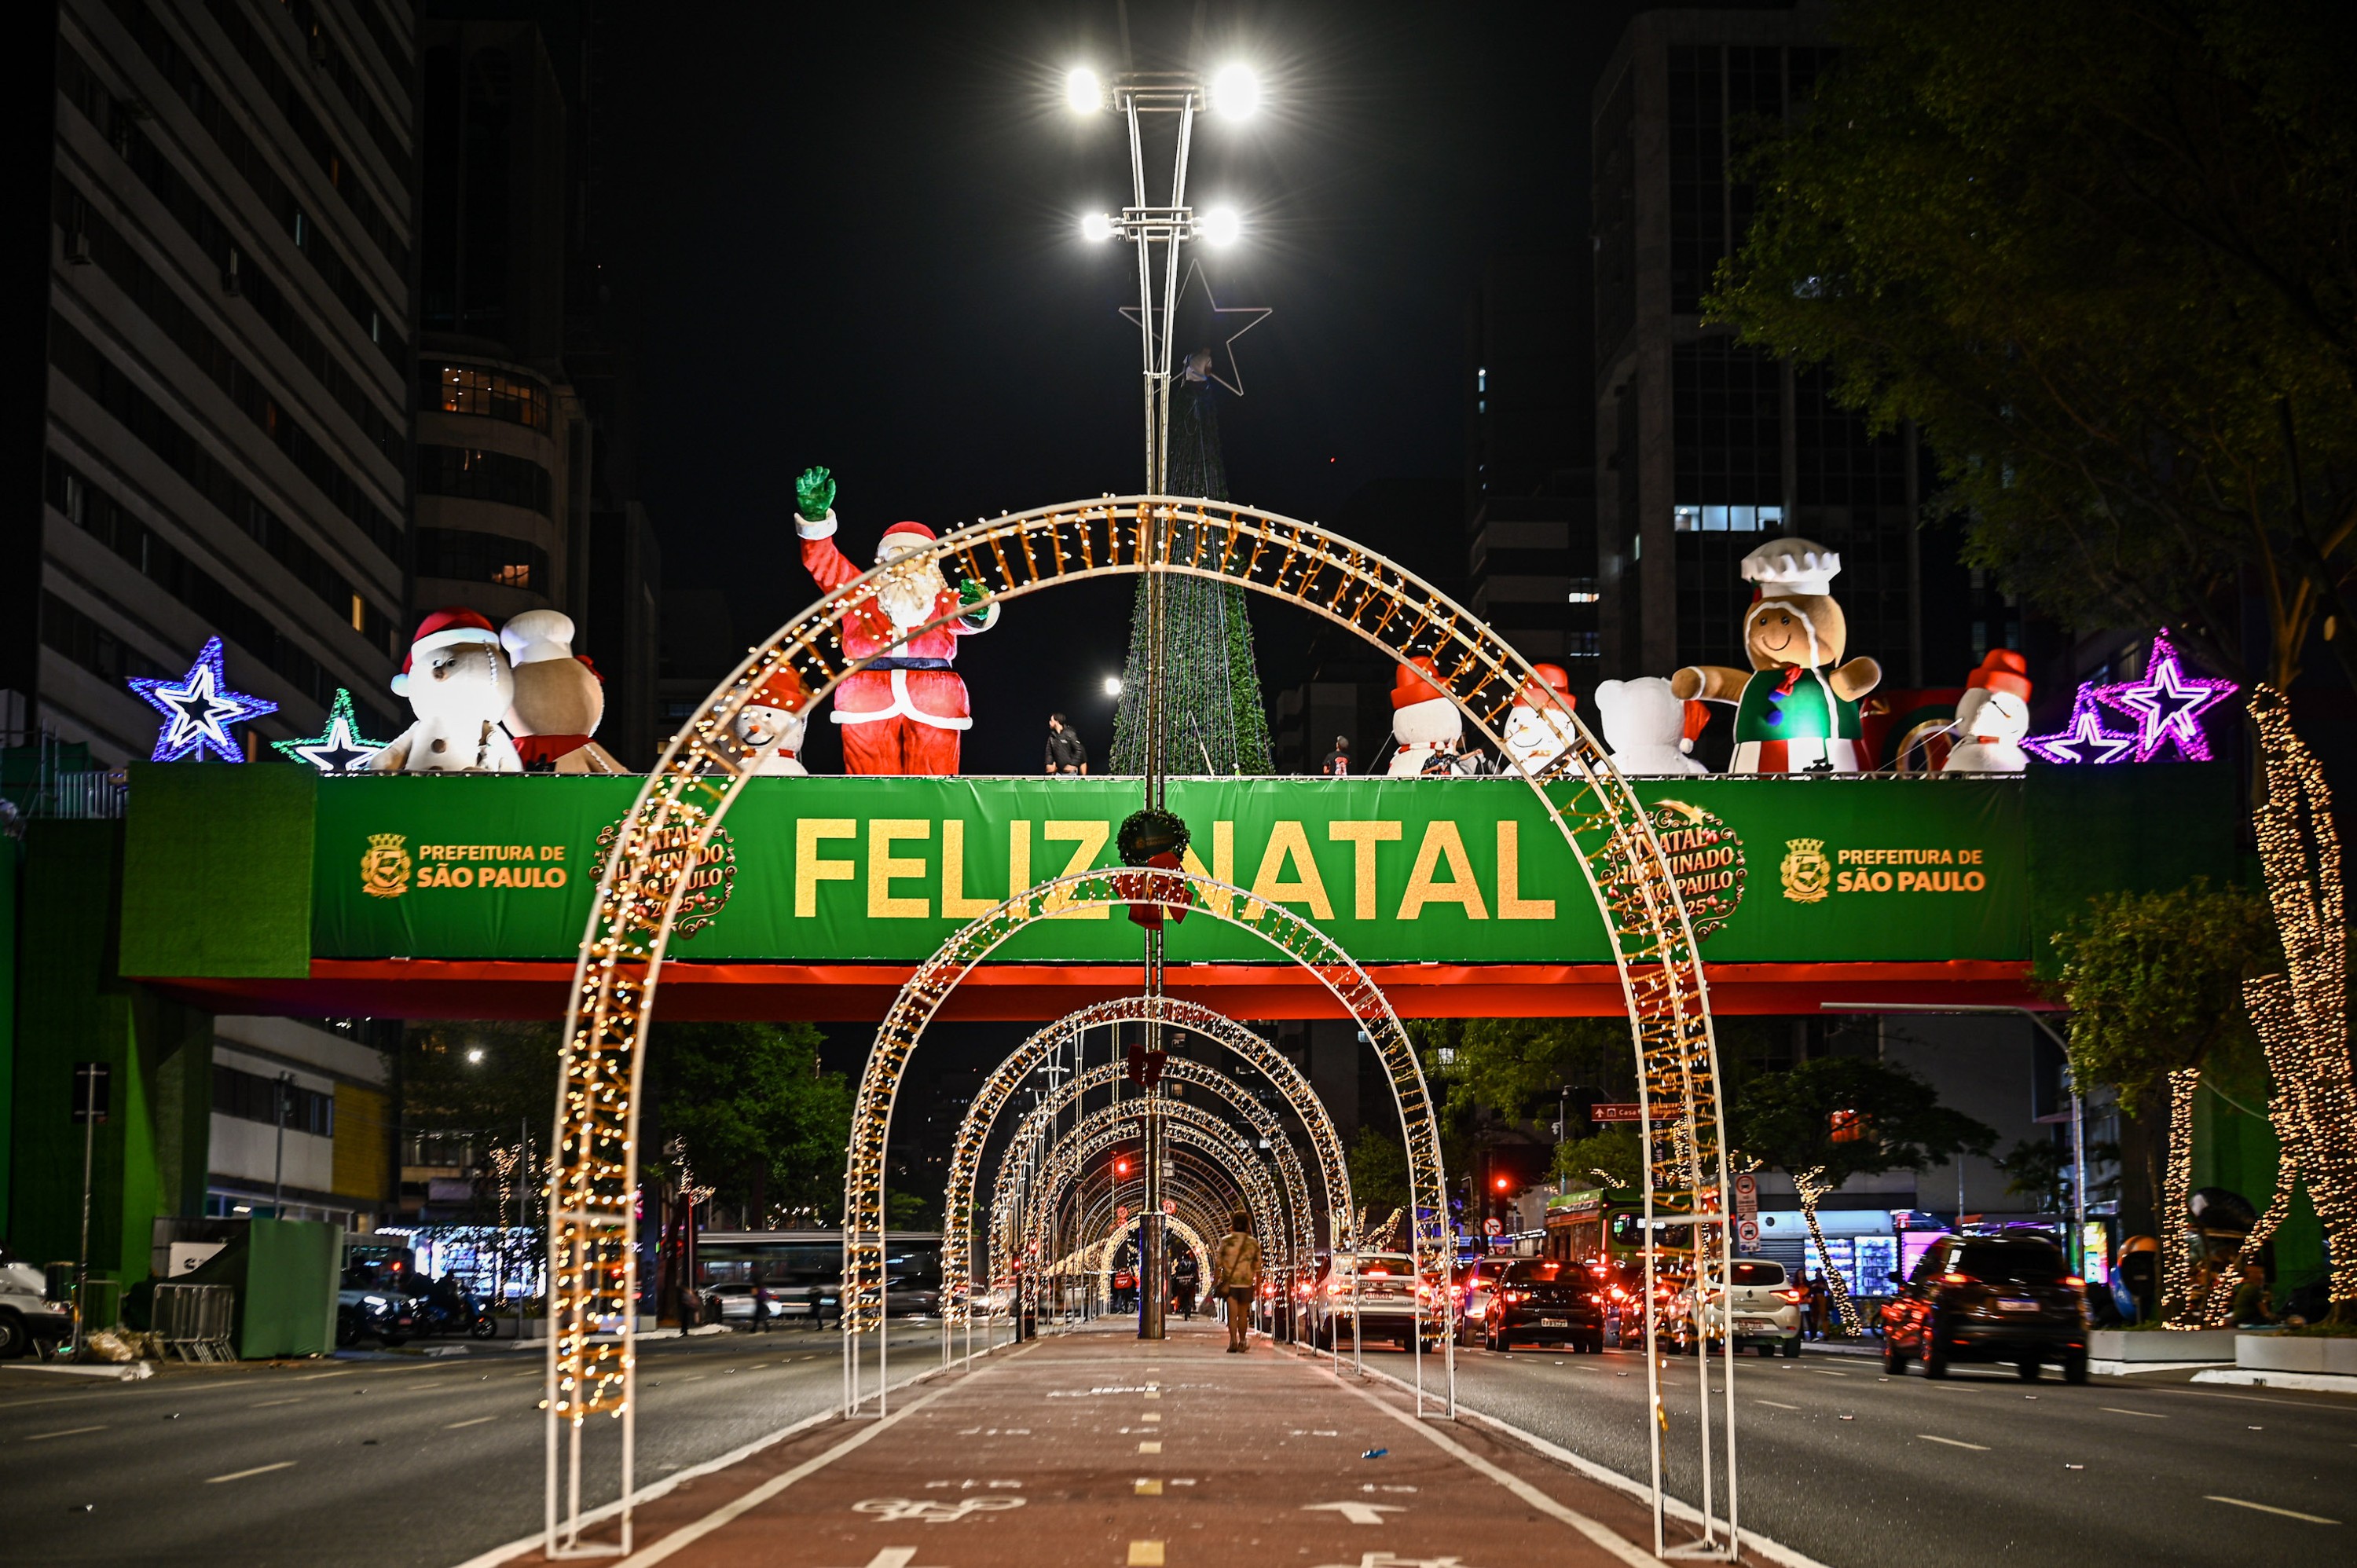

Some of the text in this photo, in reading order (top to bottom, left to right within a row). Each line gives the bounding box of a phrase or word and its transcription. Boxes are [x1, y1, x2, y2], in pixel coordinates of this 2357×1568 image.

[420, 845, 566, 861] PREFEITURA DE
[1634, 826, 1708, 859] NATAL
[794, 819, 1556, 920] FELIZ NATAL
[1838, 849, 1984, 865] PREFEITURA DE
[416, 863, 567, 888] SÃO PAULO
[1836, 867, 1985, 892] SÃO PAULO
